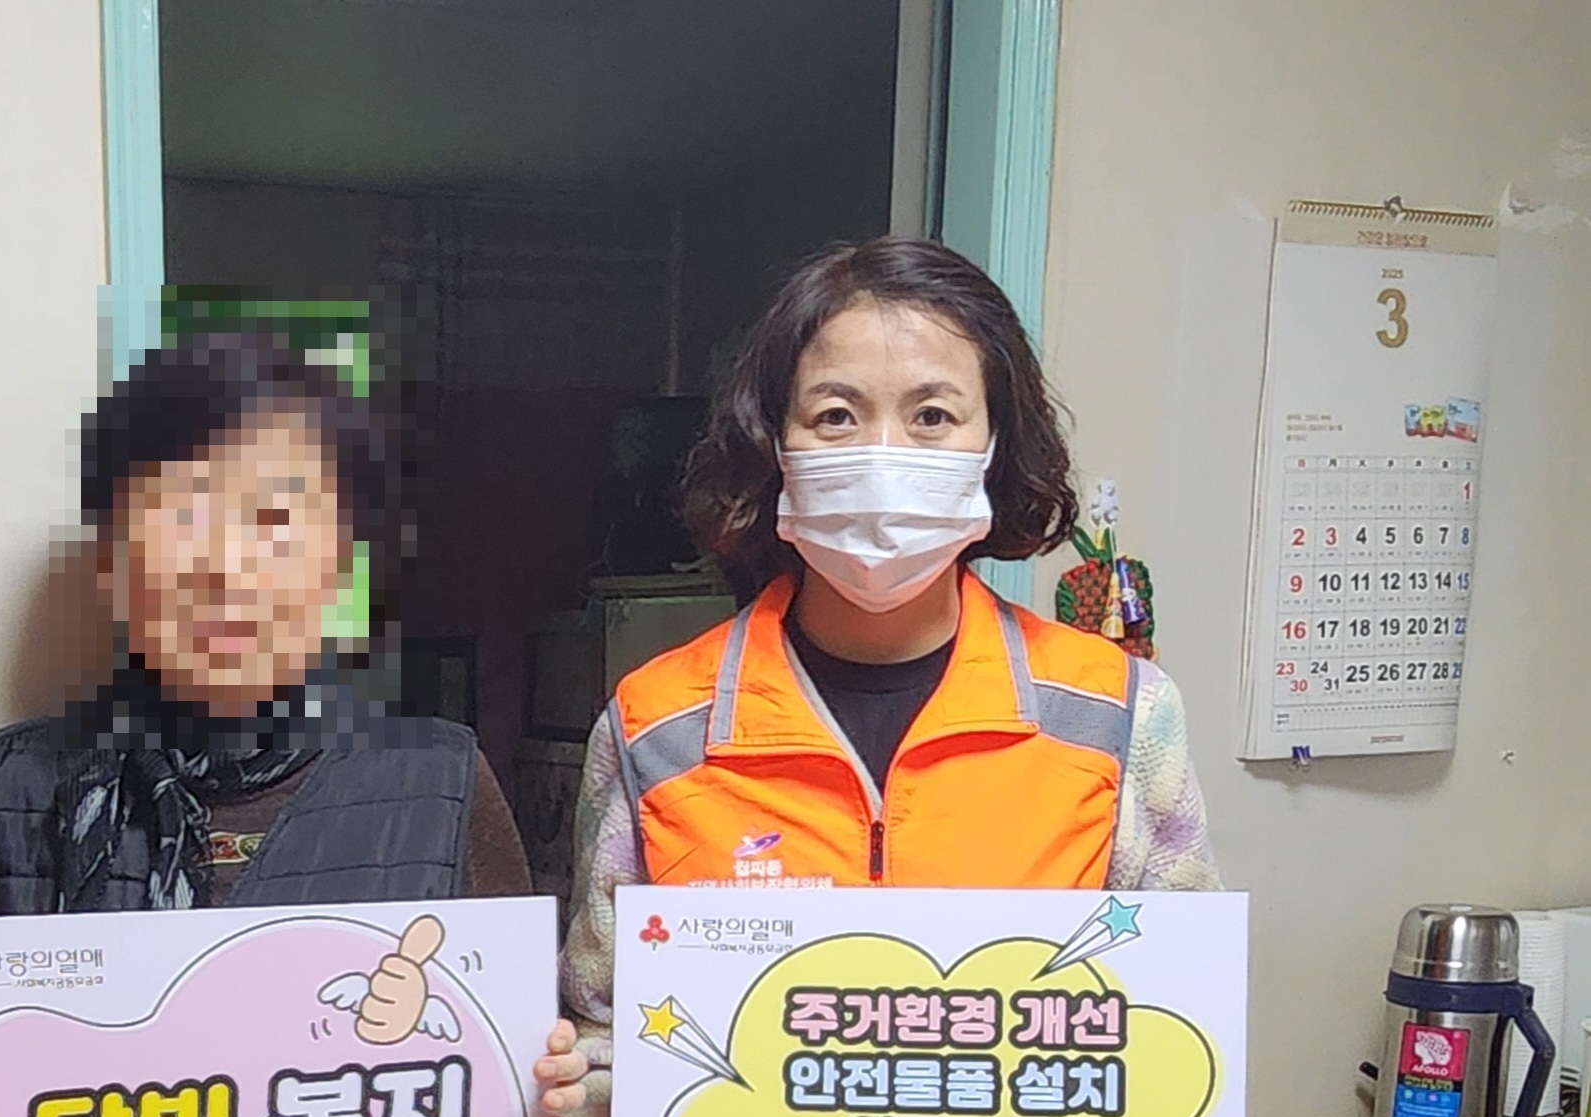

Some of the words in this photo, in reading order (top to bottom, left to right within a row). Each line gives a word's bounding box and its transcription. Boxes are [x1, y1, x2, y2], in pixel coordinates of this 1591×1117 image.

[1381, 268, 1404, 279] 2025
[1375, 287, 1409, 348] 3
[1463, 481, 1471, 500] 1
[1292, 527, 1306, 546] 2
[1325, 526, 1338, 545] 3
[1355, 526, 1367, 545] 4
[1385, 526, 1397, 545] 5
[1413, 526, 1424, 545] 6
[1438, 526, 1450, 545] 7
[1461, 526, 1470, 545] 8
[1289, 574, 1303, 593] 9
[1318, 573, 1342, 592] 10
[1350, 572, 1370, 591] 11
[1380, 572, 1401, 590] 12
[1408, 571, 1428, 590] 13
[1434, 571, 1452, 590] 14
[1457, 572, 1470, 591] 15
[1281, 620, 1307, 639] 16
[1316, 619, 1340, 638] 17
[1349, 618, 1371, 637] 18
[1379, 617, 1401, 636] 19
[1407, 617, 1428, 635] 20
[1432, 616, 1450, 635] 21
[1275, 662, 1295, 676] 23
[1310, 660, 1329, 674] 24
[1345, 664, 1370, 683] 25
[1376, 663, 1400, 681] 26
[1406, 662, 1428, 680] 27
[1432, 662, 1450, 680] 28
[1290, 679, 1308, 692] 30
[1324, 677, 1340, 691] 31
[733, 859, 783, 877] 월피동
[677, 917, 794, 942] 사랑의열매
[784, 988, 1002, 1048] 주거환경
[1011, 992, 1128, 1050] 개선
[784, 1053, 1002, 1113] 안전물품
[1010, 1057, 1125, 1117] 설치
